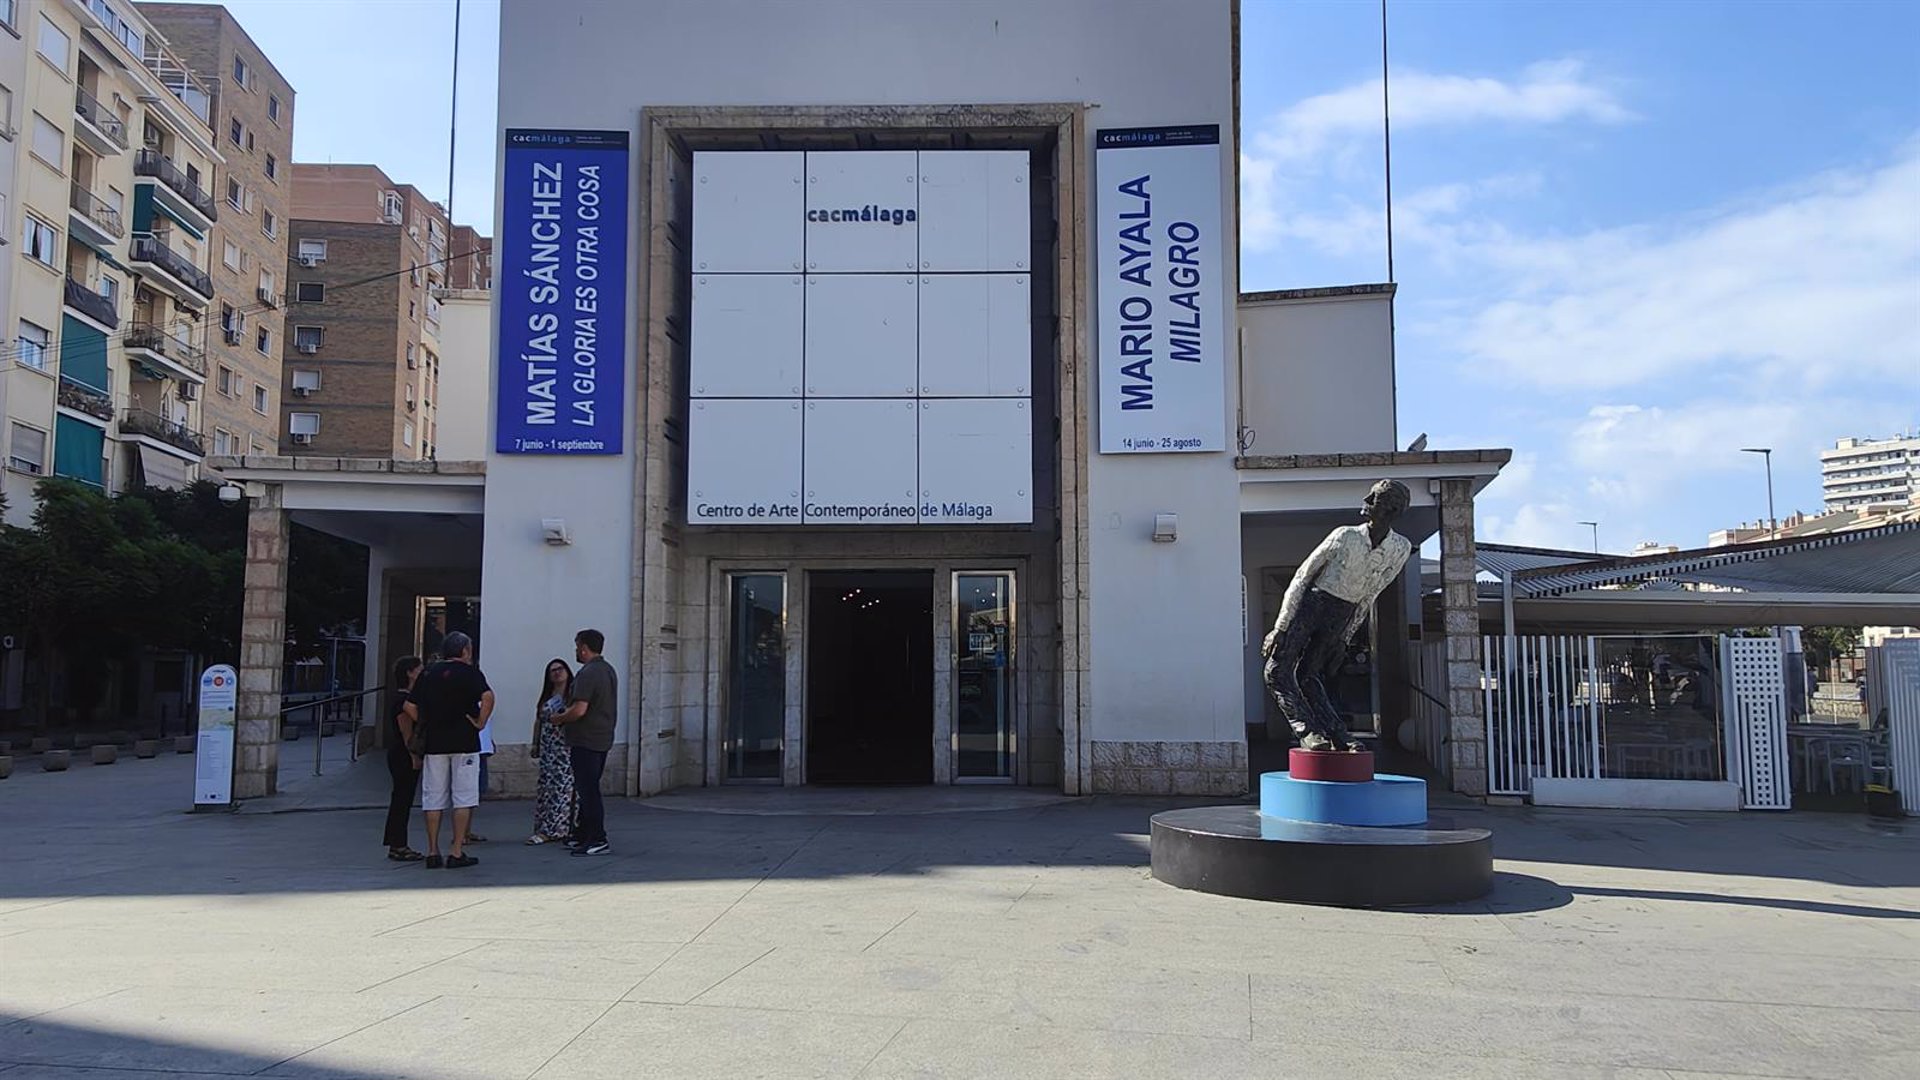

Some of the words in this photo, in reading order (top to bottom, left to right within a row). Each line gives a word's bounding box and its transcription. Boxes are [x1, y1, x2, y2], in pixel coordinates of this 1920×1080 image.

[577, 166, 600, 220] COSA
[807, 204, 916, 226] cacmálaga
[523, 162, 562, 304] SÁNCHEZ
[576, 226, 599, 280] OTRA
[1118, 174, 1152, 287] AYALA
[575, 286, 598, 313] ES
[1167, 222, 1201, 363] MILAGRO
[521, 313, 558, 424] MATÍAS
[572, 318, 596, 394] GLORIA
[1120, 296, 1153, 410] MARIO
[572, 400, 594, 426] LA
[515, 438, 520, 449] 7
[522, 438, 544, 452] junio
[558, 439, 604, 452] septiembre
[1122, 438, 1132, 448] 14
[1133, 438, 1154, 450] junio
[1162, 438, 1171, 448] 25
[1173, 438, 1202, 450] agosto
[697, 503, 744, 518] Centro
[747, 503, 766, 518] de
[768, 503, 798, 518] Arte
[804, 502, 916, 519] Contemporáneo
[920, 502, 938, 517] de
[942, 501, 992, 520] Málaga
